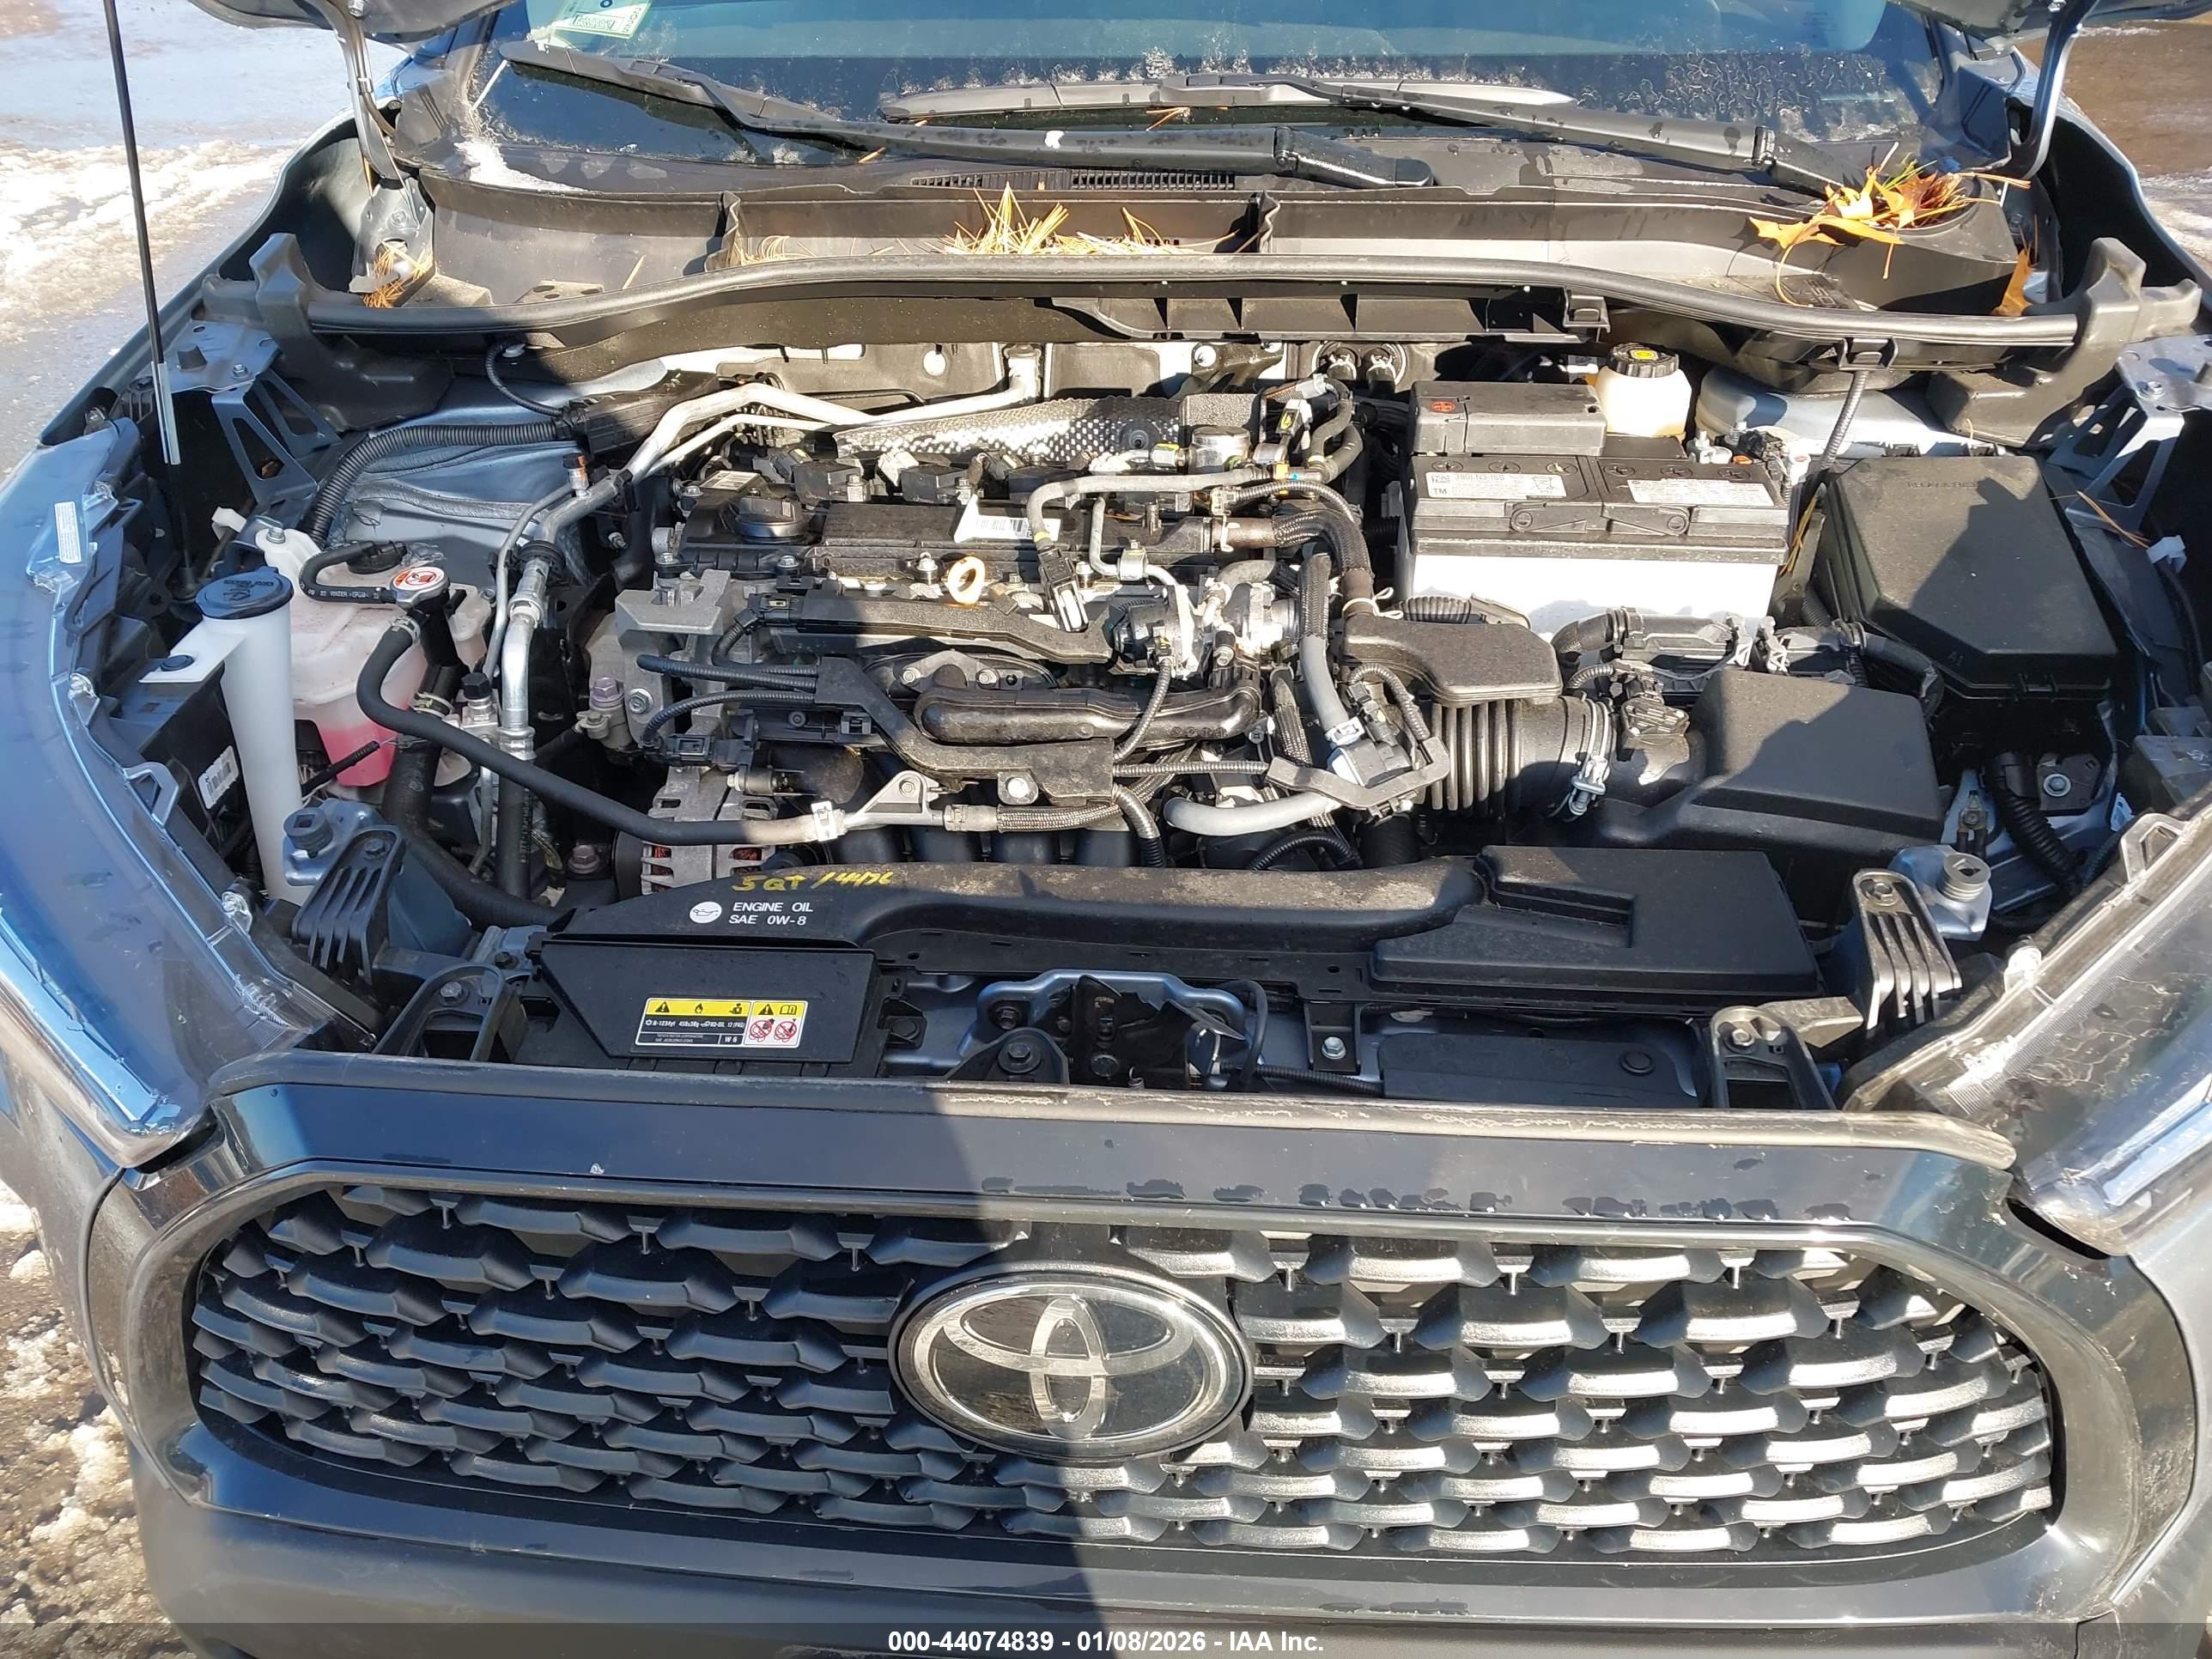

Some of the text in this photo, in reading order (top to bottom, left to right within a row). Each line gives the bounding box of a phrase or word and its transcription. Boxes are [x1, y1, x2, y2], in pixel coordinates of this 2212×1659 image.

[732, 902, 813, 912] ENGINE OIL
[729, 915, 806, 925] SAE 0W-8
